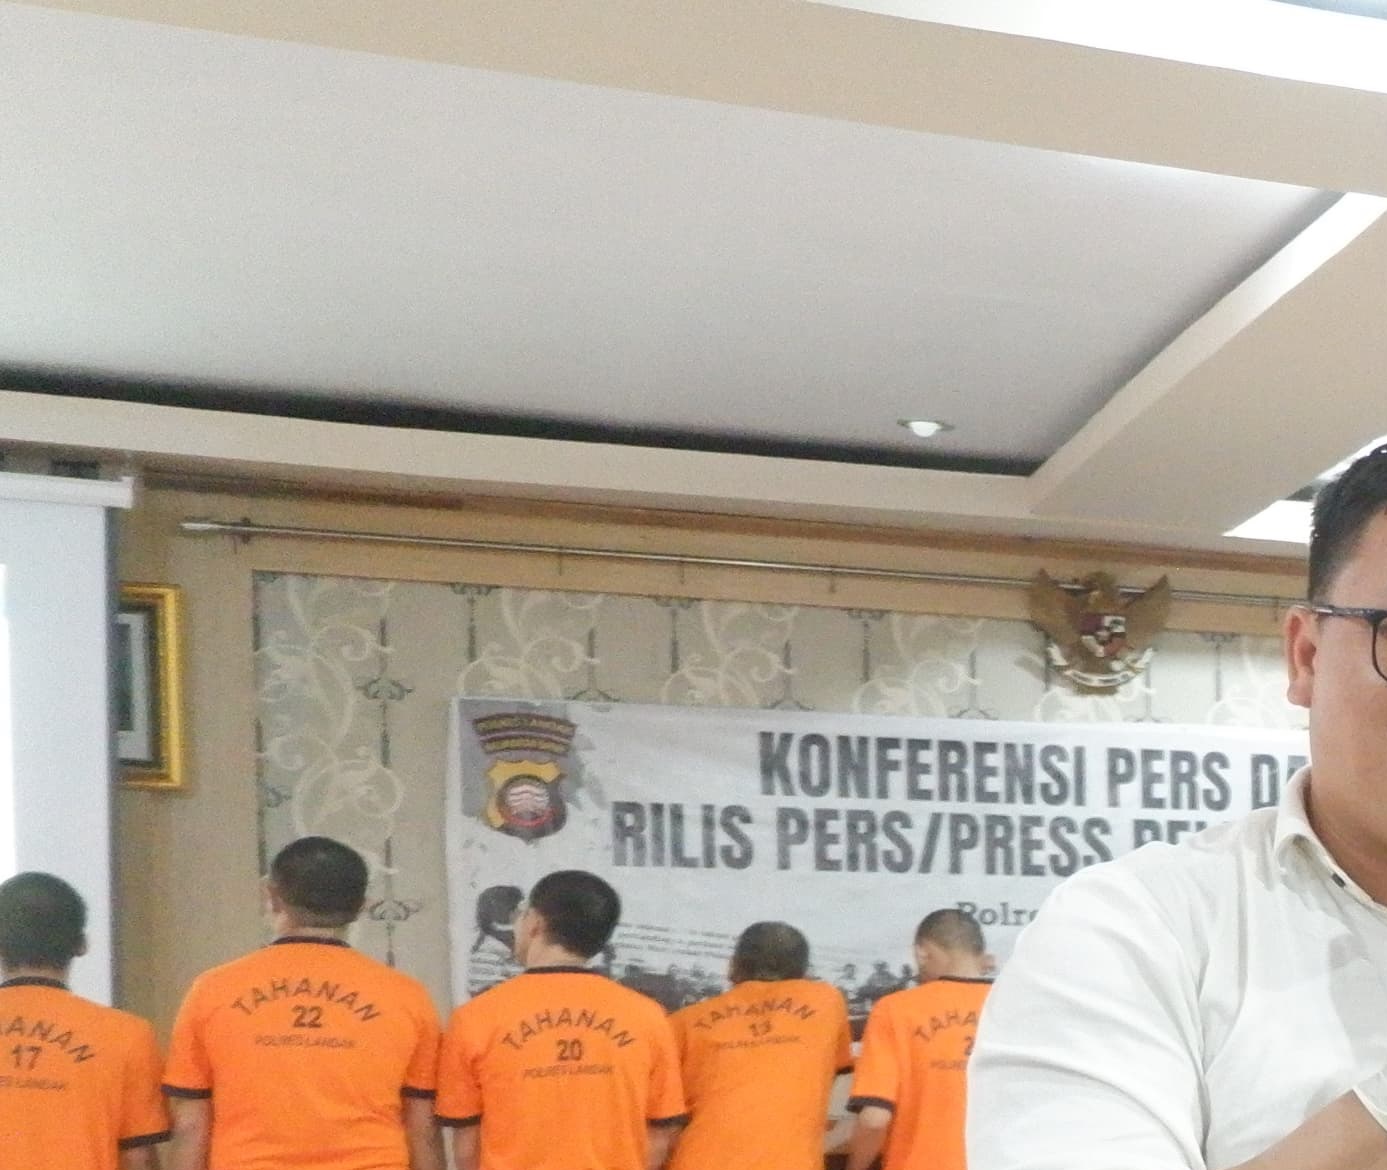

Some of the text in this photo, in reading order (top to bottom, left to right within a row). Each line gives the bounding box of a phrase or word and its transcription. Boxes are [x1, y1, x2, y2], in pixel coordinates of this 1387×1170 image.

[758, 731, 1086, 806] KONFERENSI
[1106, 747, 1231, 811] PERS
[612, 801, 753, 869] RILIS
[776, 806, 1114, 877] PERS/PRESS
[231, 978, 381, 1021] TAHANAN
[292, 1004, 323, 1028] 22
[694, 997, 817, 1031] TAHANAN
[0, 1016, 95, 1063] ANAN
[502, 1008, 636, 1050] TAHANAN
[912, 1009, 978, 1042] TAHA
[12, 1044, 42, 1071] 17
[556, 1038, 583, 1062] 20
